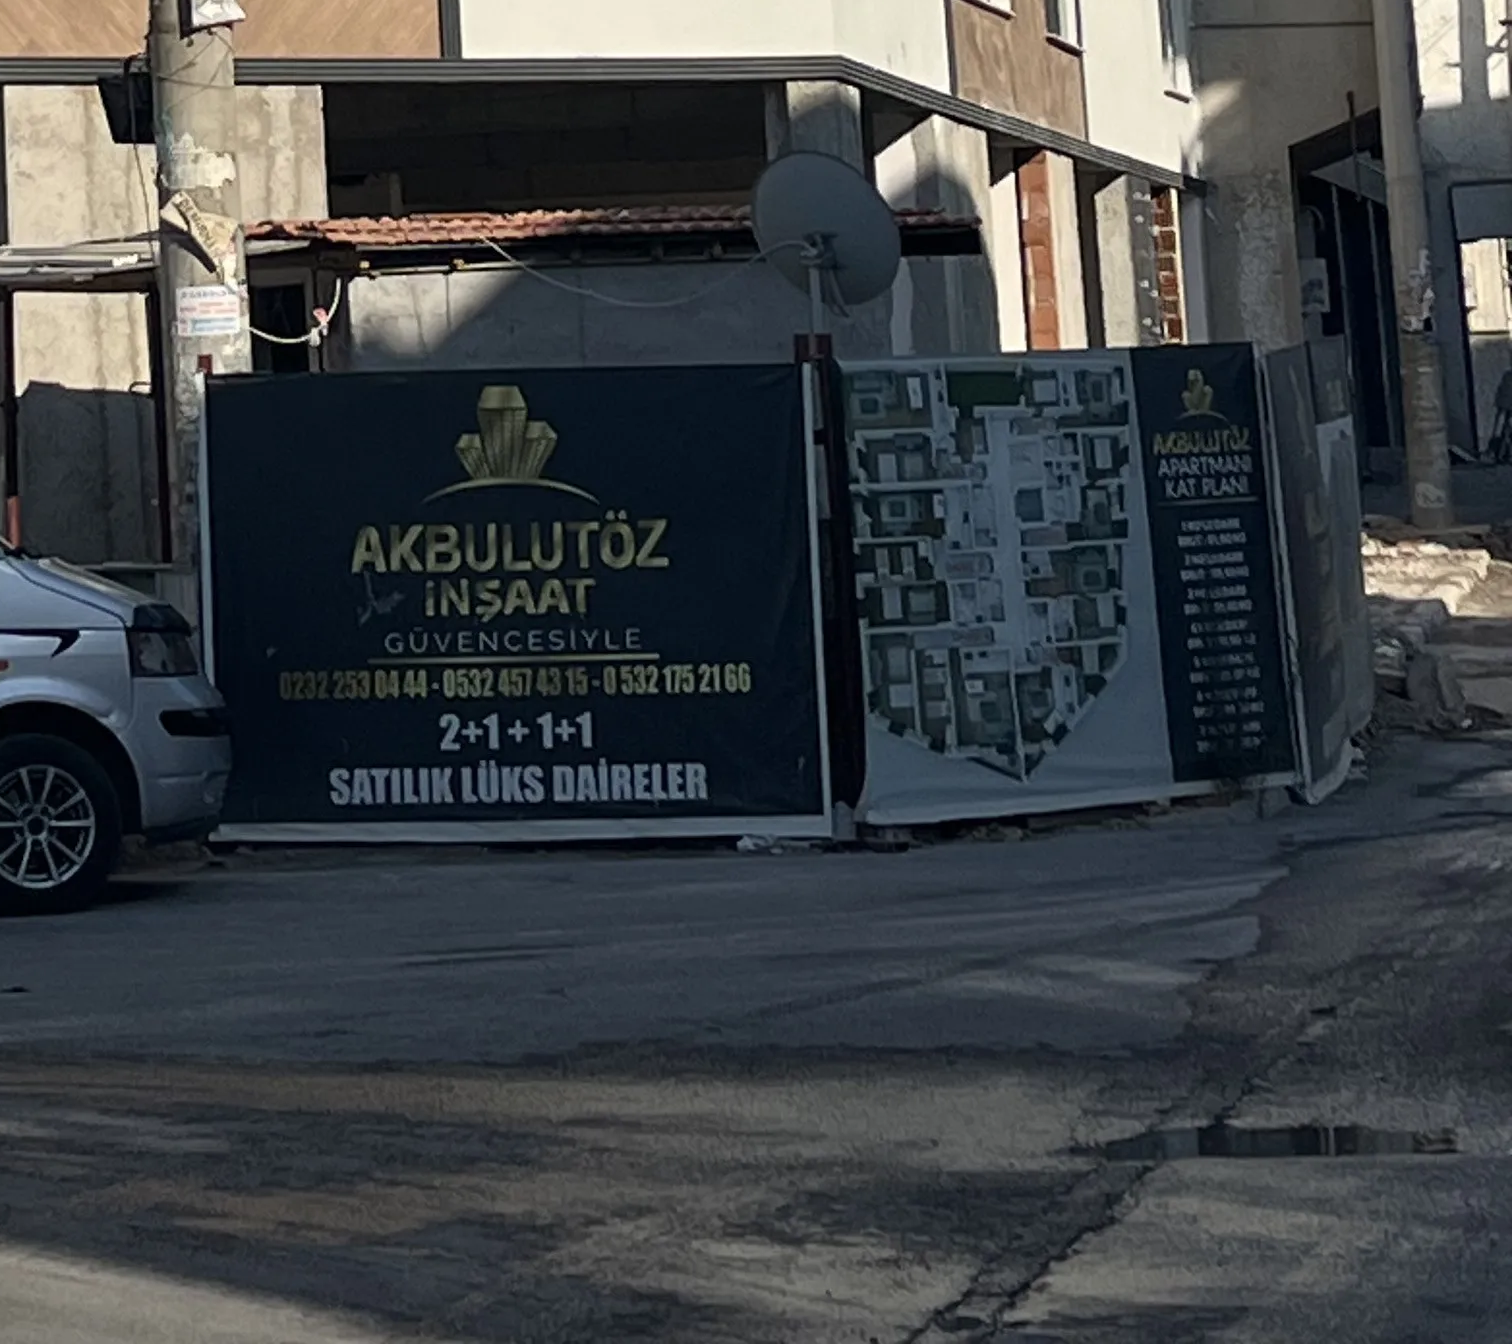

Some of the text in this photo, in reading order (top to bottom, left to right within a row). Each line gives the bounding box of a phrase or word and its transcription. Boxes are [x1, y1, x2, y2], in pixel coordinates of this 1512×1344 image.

[1165, 477, 1197, 499] KAT
[351, 510, 671, 575] AKBULUTÖZ
[332, 670, 371, 700] 253
[374, 668, 400, 699] 04
[403, 668, 428, 699] 44
[442, 667, 495, 699] 0532
[498, 667, 533, 698] 457
[536, 666, 562, 697] 43
[564, 666, 589, 696] 15
[619, 665, 660, 695] 532
[662, 664, 696, 694] 175
[698, 663, 722, 694] 21
[439, 712, 500, 752] 2+1
[536, 710, 594, 750] 1+1
[329, 757, 709, 806] SATILIK LÜKS DAİRELER
